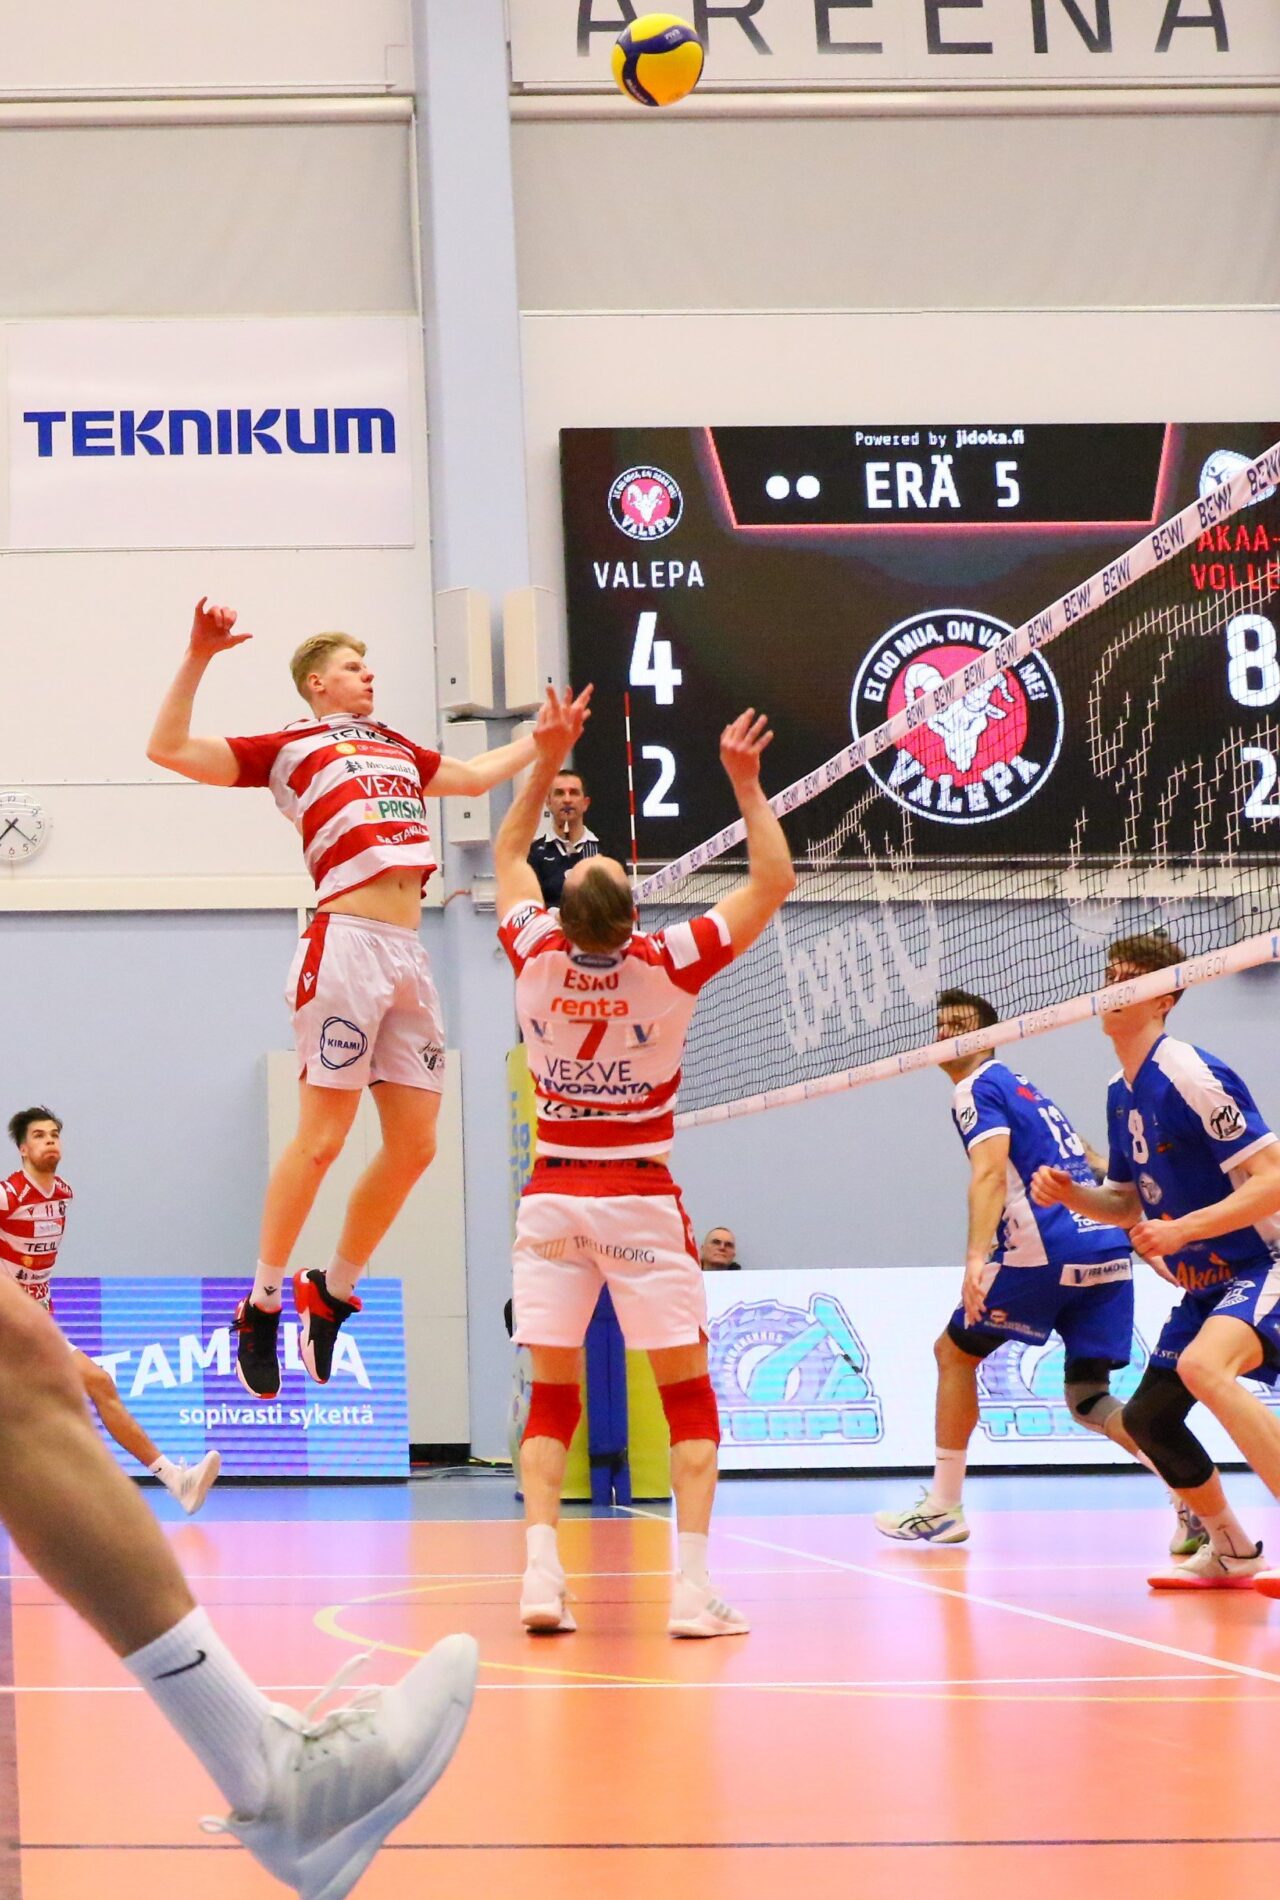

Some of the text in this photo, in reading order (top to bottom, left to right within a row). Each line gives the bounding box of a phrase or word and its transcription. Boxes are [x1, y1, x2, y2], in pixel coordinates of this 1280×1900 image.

[23, 407, 396, 457] TEKNIKUM
[855, 429, 1024, 448] Powered by jidoka.fi
[865, 454, 1020, 508] ERÄ 5
[593, 561, 704, 589] VALEPA
[964, 659, 987, 690] BEWI
[995, 634, 1018, 669] BEWI
[1028, 612, 1053, 648] BEWI
[1063, 584, 1091, 622] BEWI
[1103, 556, 1131, 597] BEWI
[1152, 518, 1185, 561] BEWI
[1197, 484, 1232, 530] BEWI
[629, 612, 682, 704] 4
[864, 677, 887, 702] EI
[895, 623, 944, 658] MUA,
[947, 621, 973, 641] ON
[1227, 614, 1280, 707] 8
[642, 745, 679, 817] 2
[888, 748, 1041, 813] VALEPA
[1242, 747, 1280, 818] 2
[550, 996, 629, 1017] renta
[327, 1038, 360, 1050] KIRAMI
[569, 1019, 608, 1060] 7
[545, 1056, 632, 1082] VEXVE
[1128, 1108, 1149, 1164] 8
[573, 1236, 655, 1264] TRELLEBORG
[90, 1322, 372, 1398] TAMLA
[179, 1403, 374, 1430] sopivasti sykettä
